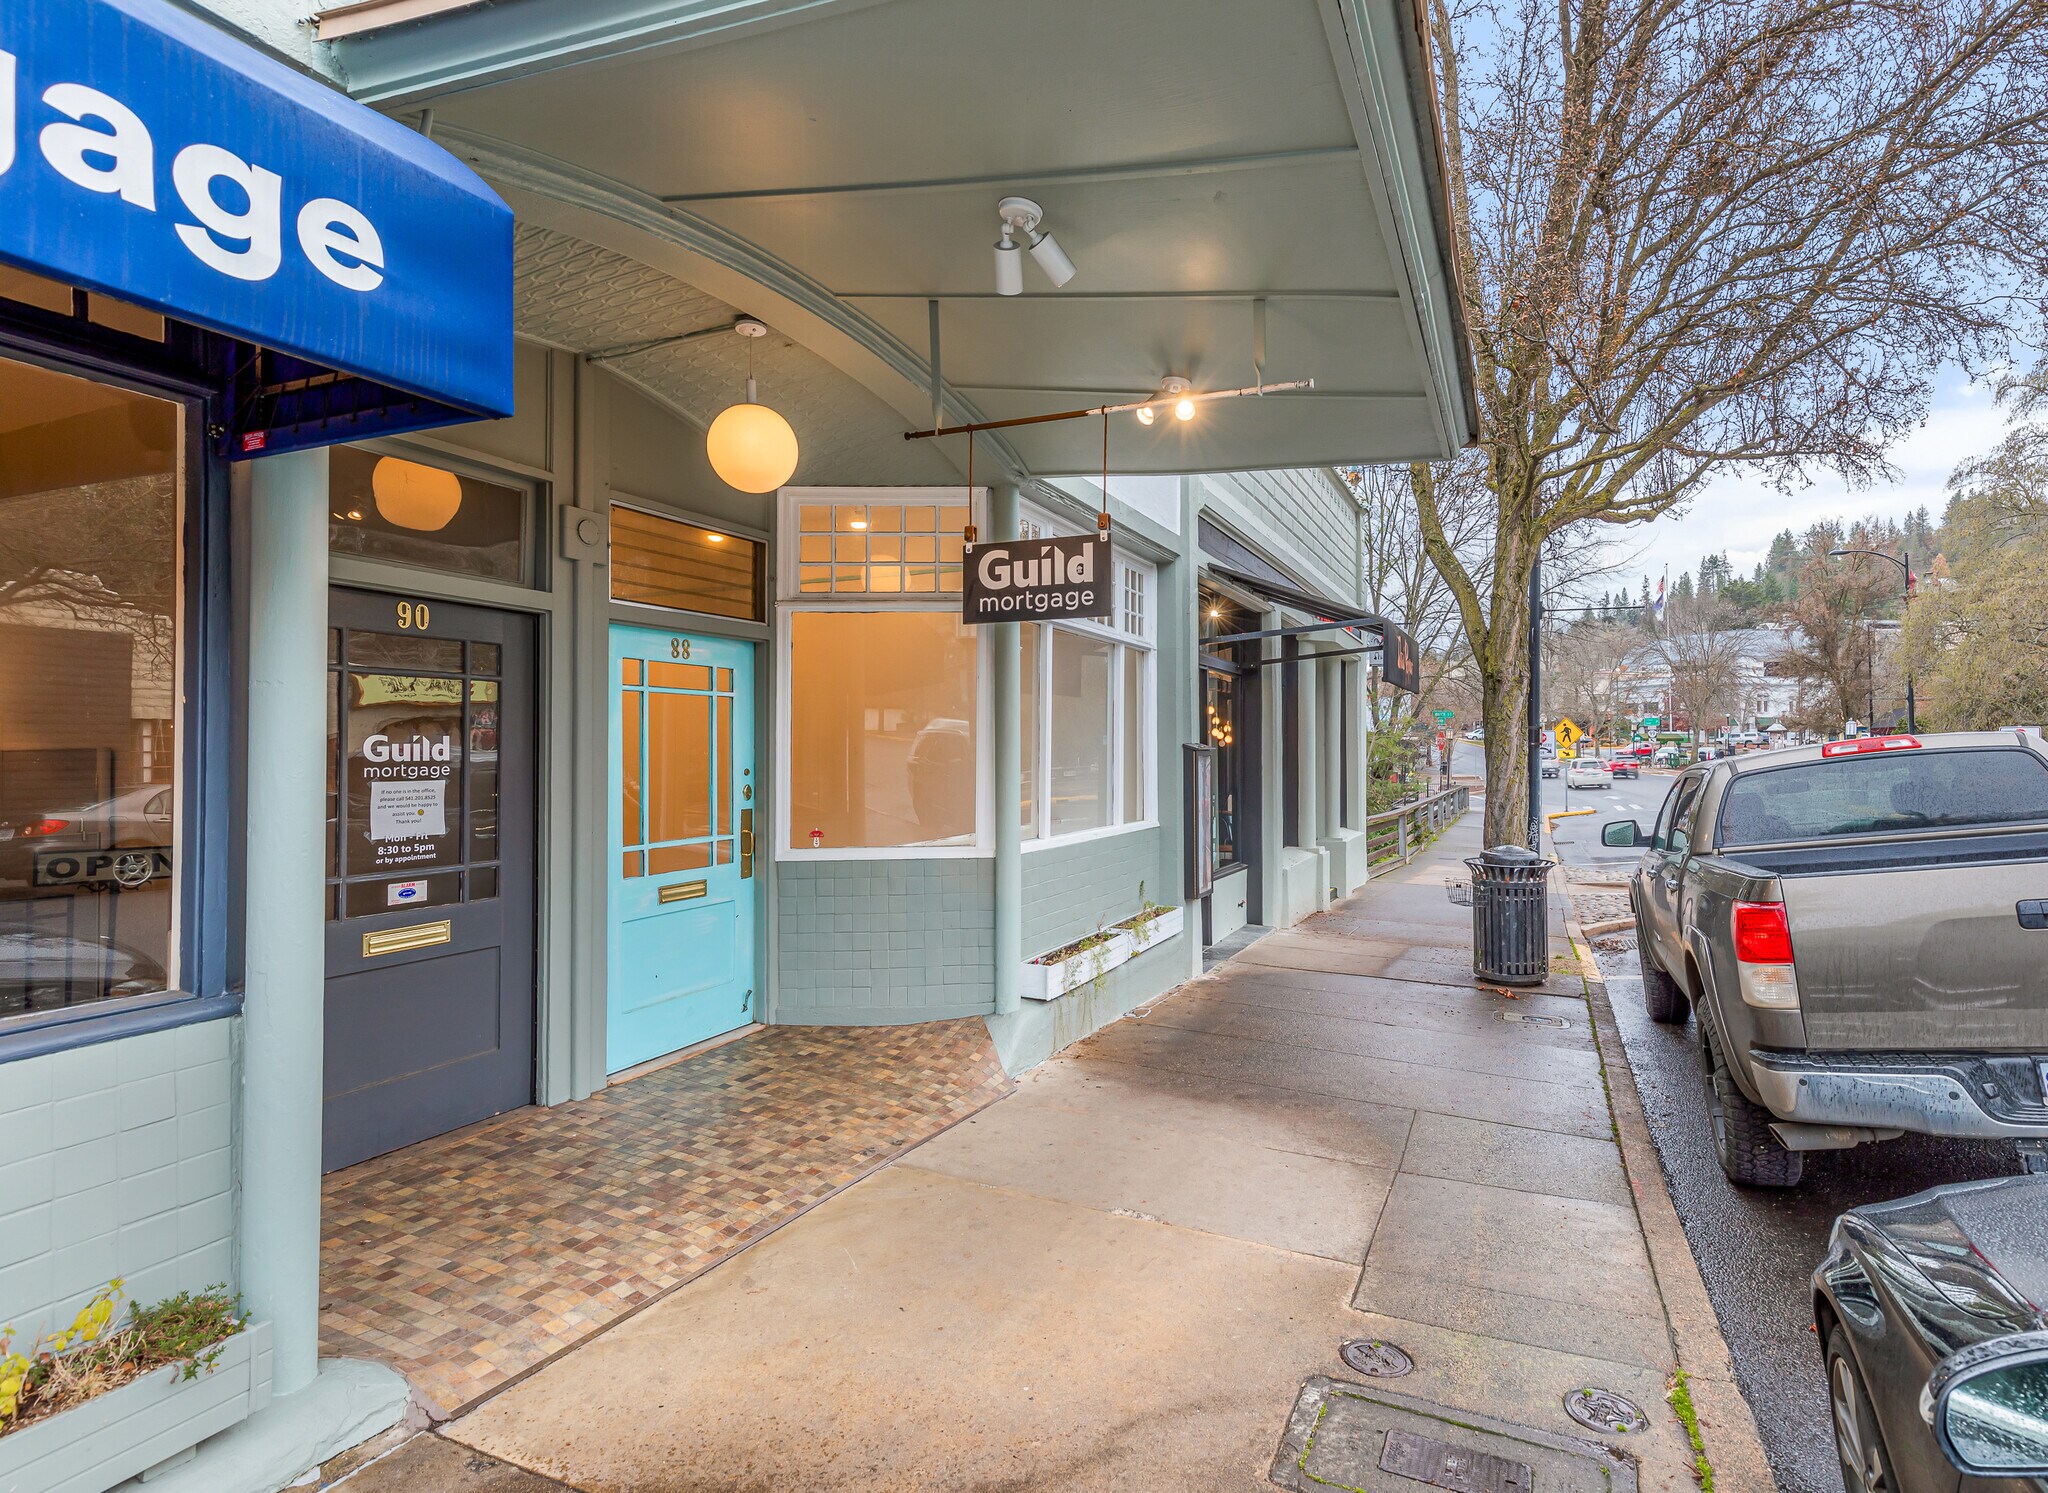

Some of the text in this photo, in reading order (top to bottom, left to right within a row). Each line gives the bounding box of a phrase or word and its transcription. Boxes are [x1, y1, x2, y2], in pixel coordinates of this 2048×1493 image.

[0, 49, 386, 292] age
[978, 542, 1094, 590] Guild
[979, 589, 1095, 613] mortgage
[396, 601, 430, 631] 90
[670, 637, 691, 660] 88
[363, 734, 450, 763] Guild
[363, 764, 451, 779] mortgage
[385, 834, 407, 843] Mon
[415, 832, 429, 841] Fri
[377, 843, 435, 856] 8:30 to 5pm
[384, 856, 394, 865] by
[394, 853, 436, 863] appointment
